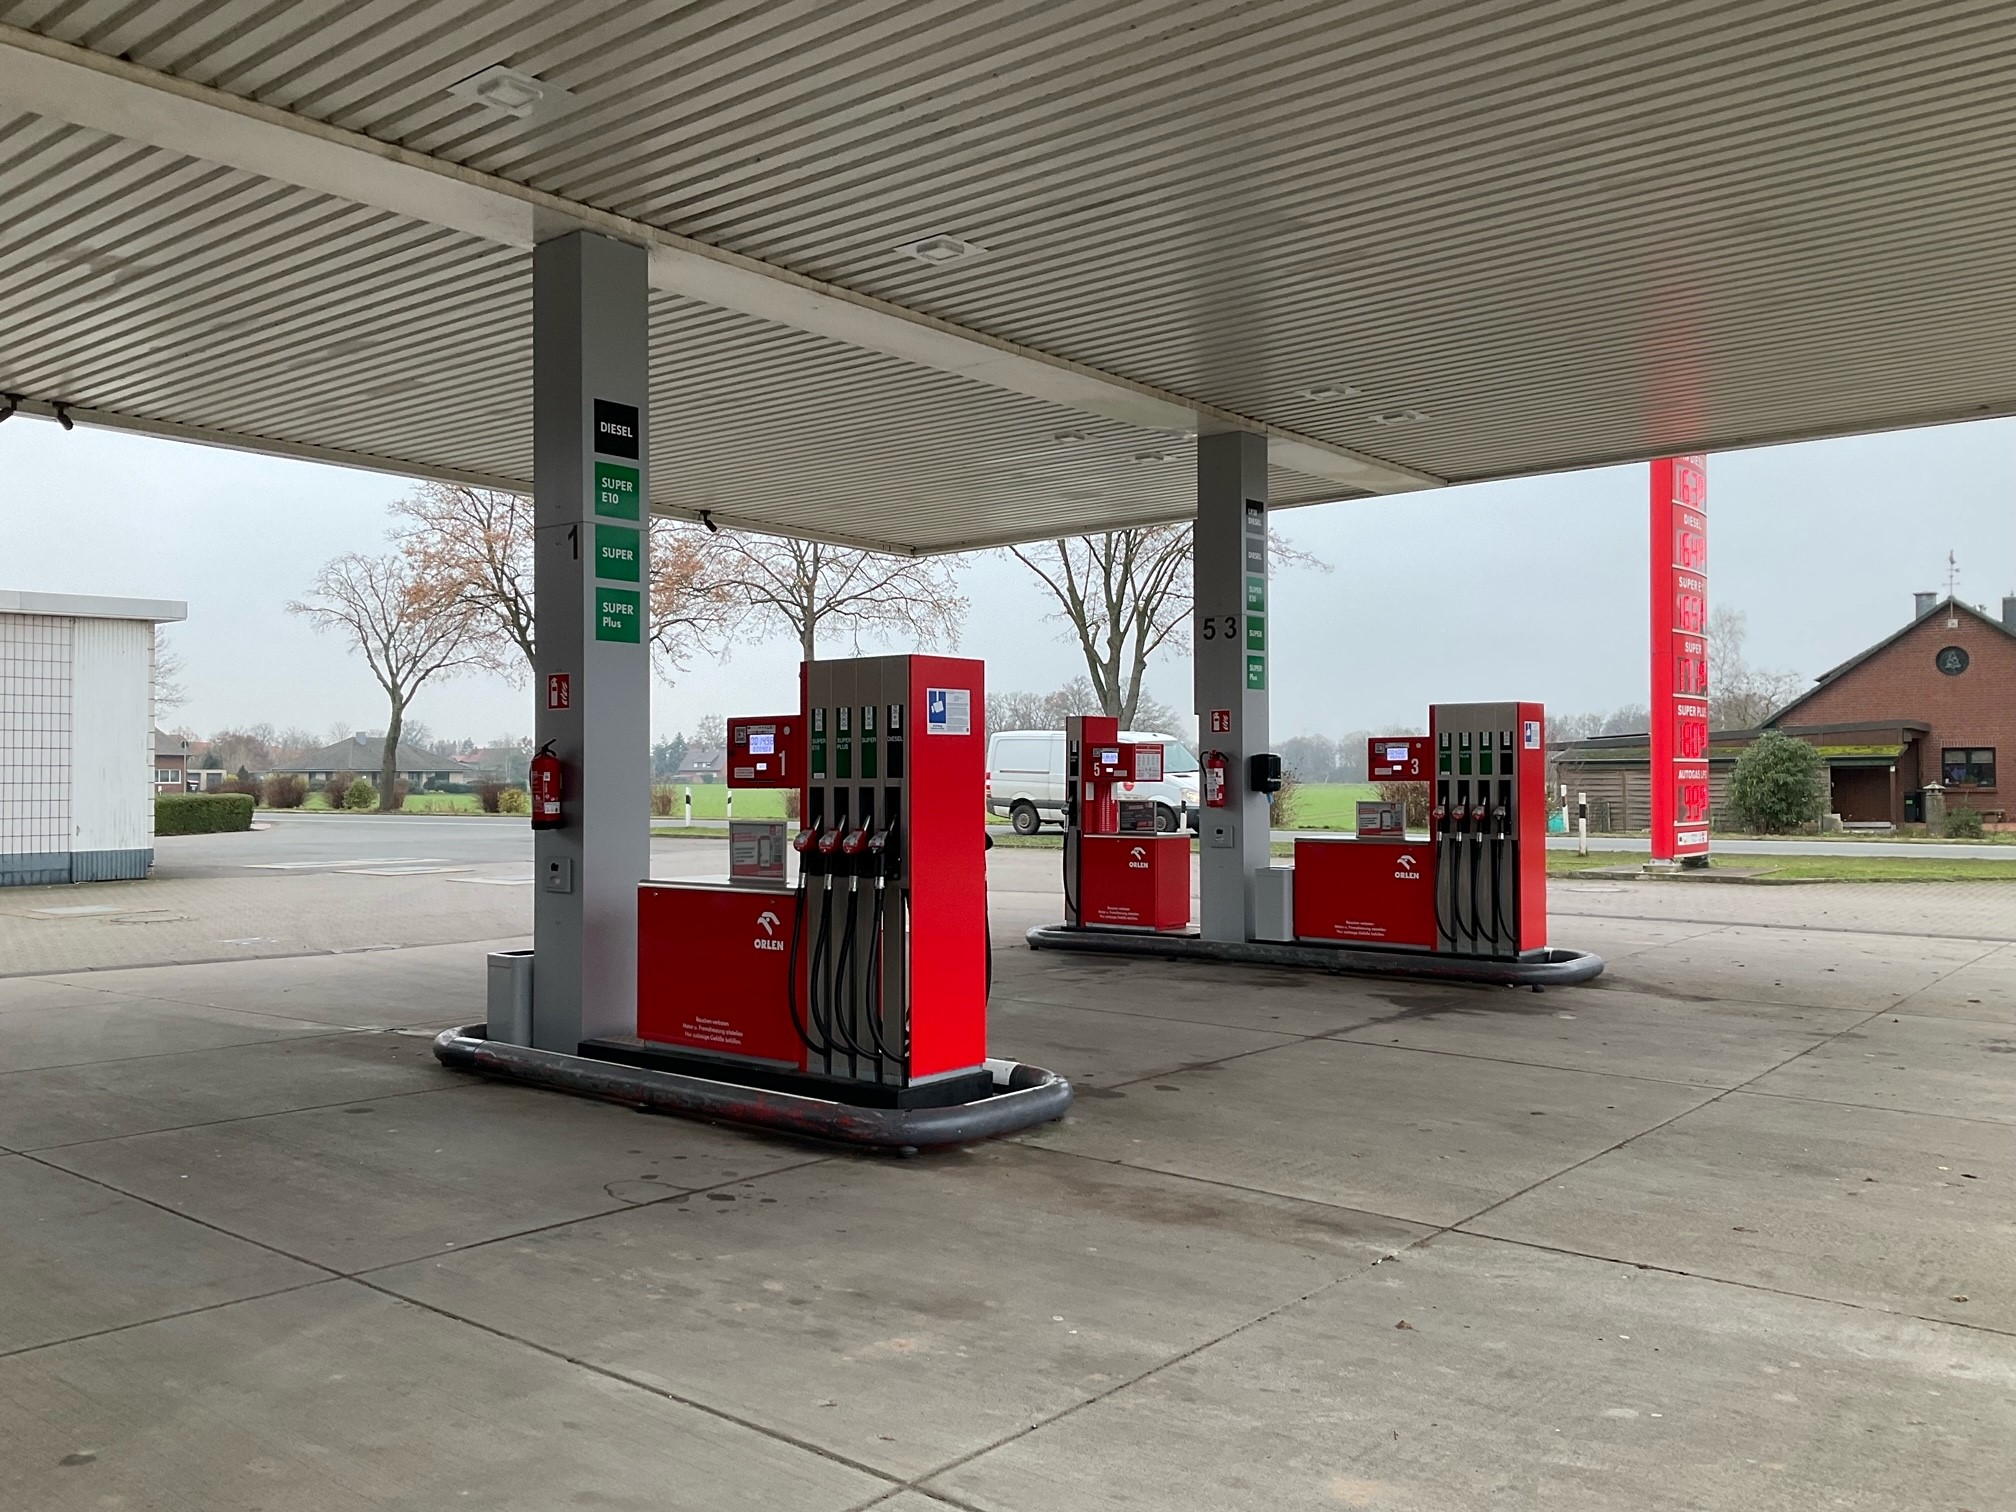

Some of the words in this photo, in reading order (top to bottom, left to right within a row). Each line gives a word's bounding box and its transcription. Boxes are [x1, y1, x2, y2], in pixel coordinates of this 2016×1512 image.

[600, 421, 633, 438] DIESEL
[601, 477, 633, 492] SUPER
[601, 492, 619, 504] E10
[1683, 513, 1702, 530] DIESEL
[567, 524, 578, 560] 1
[602, 546, 633, 561] SUPER
[1248, 585, 1263, 595] SUPER
[1678, 576, 1698, 591] SUPER
[602, 601, 634, 616] SUPER
[602, 616, 622, 629] Plus
[1203, 617, 1216, 640] 5
[1224, 616, 1237, 640] 3
[1248, 629, 1263, 638] SUPER
[1684, 641, 1703, 655] SUPER
[1249, 664, 1263, 673] SUPER
[1677, 704, 1697, 717] SUPER
[861, 736, 877, 744] SUPER
[778, 750, 786, 776] 1
[1093, 762, 1101, 777] 5
[1411, 758, 1419, 775] 3
[1128, 861, 1149, 869] ORLEN
[1394, 871, 1420, 880] ORLEN
[753, 938, 784, 951] ORLEN
